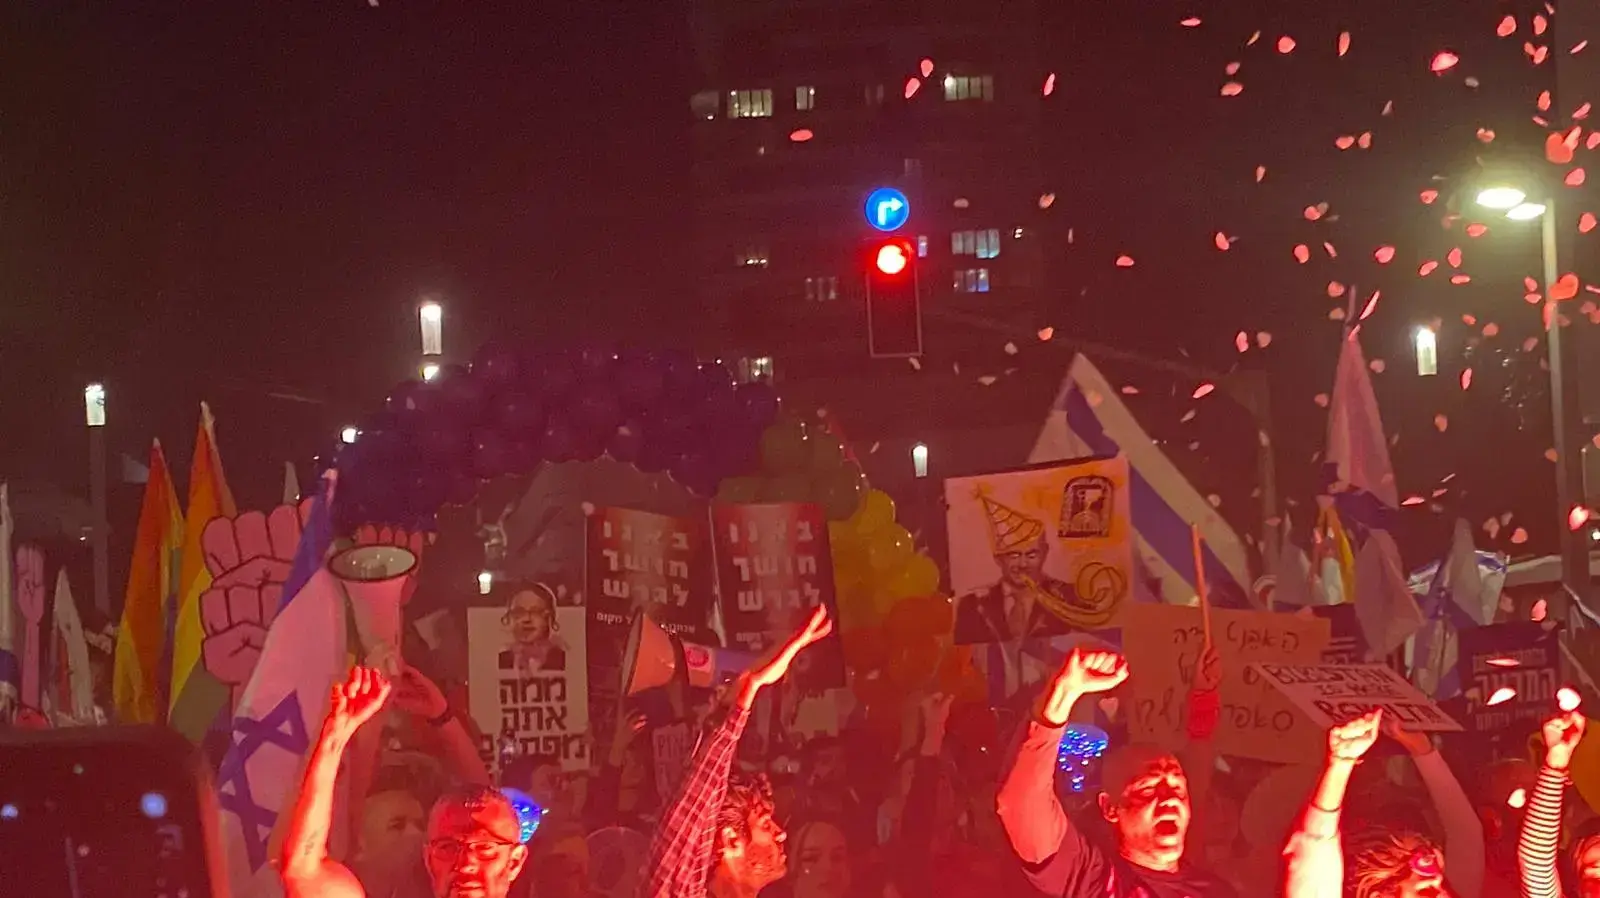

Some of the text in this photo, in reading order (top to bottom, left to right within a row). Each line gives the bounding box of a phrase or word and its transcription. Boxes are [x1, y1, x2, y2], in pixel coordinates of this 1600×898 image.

[603, 521, 689, 549] באנו
[729, 521, 813, 543] באנו
[603, 549, 689, 579] חושך
[733, 555, 817, 581] חושך
[603, 578, 689, 607] לגרש
[738, 582, 820, 612] לגרש
[501, 676, 566, 704] ממה
[502, 706, 567, 731] אתה
